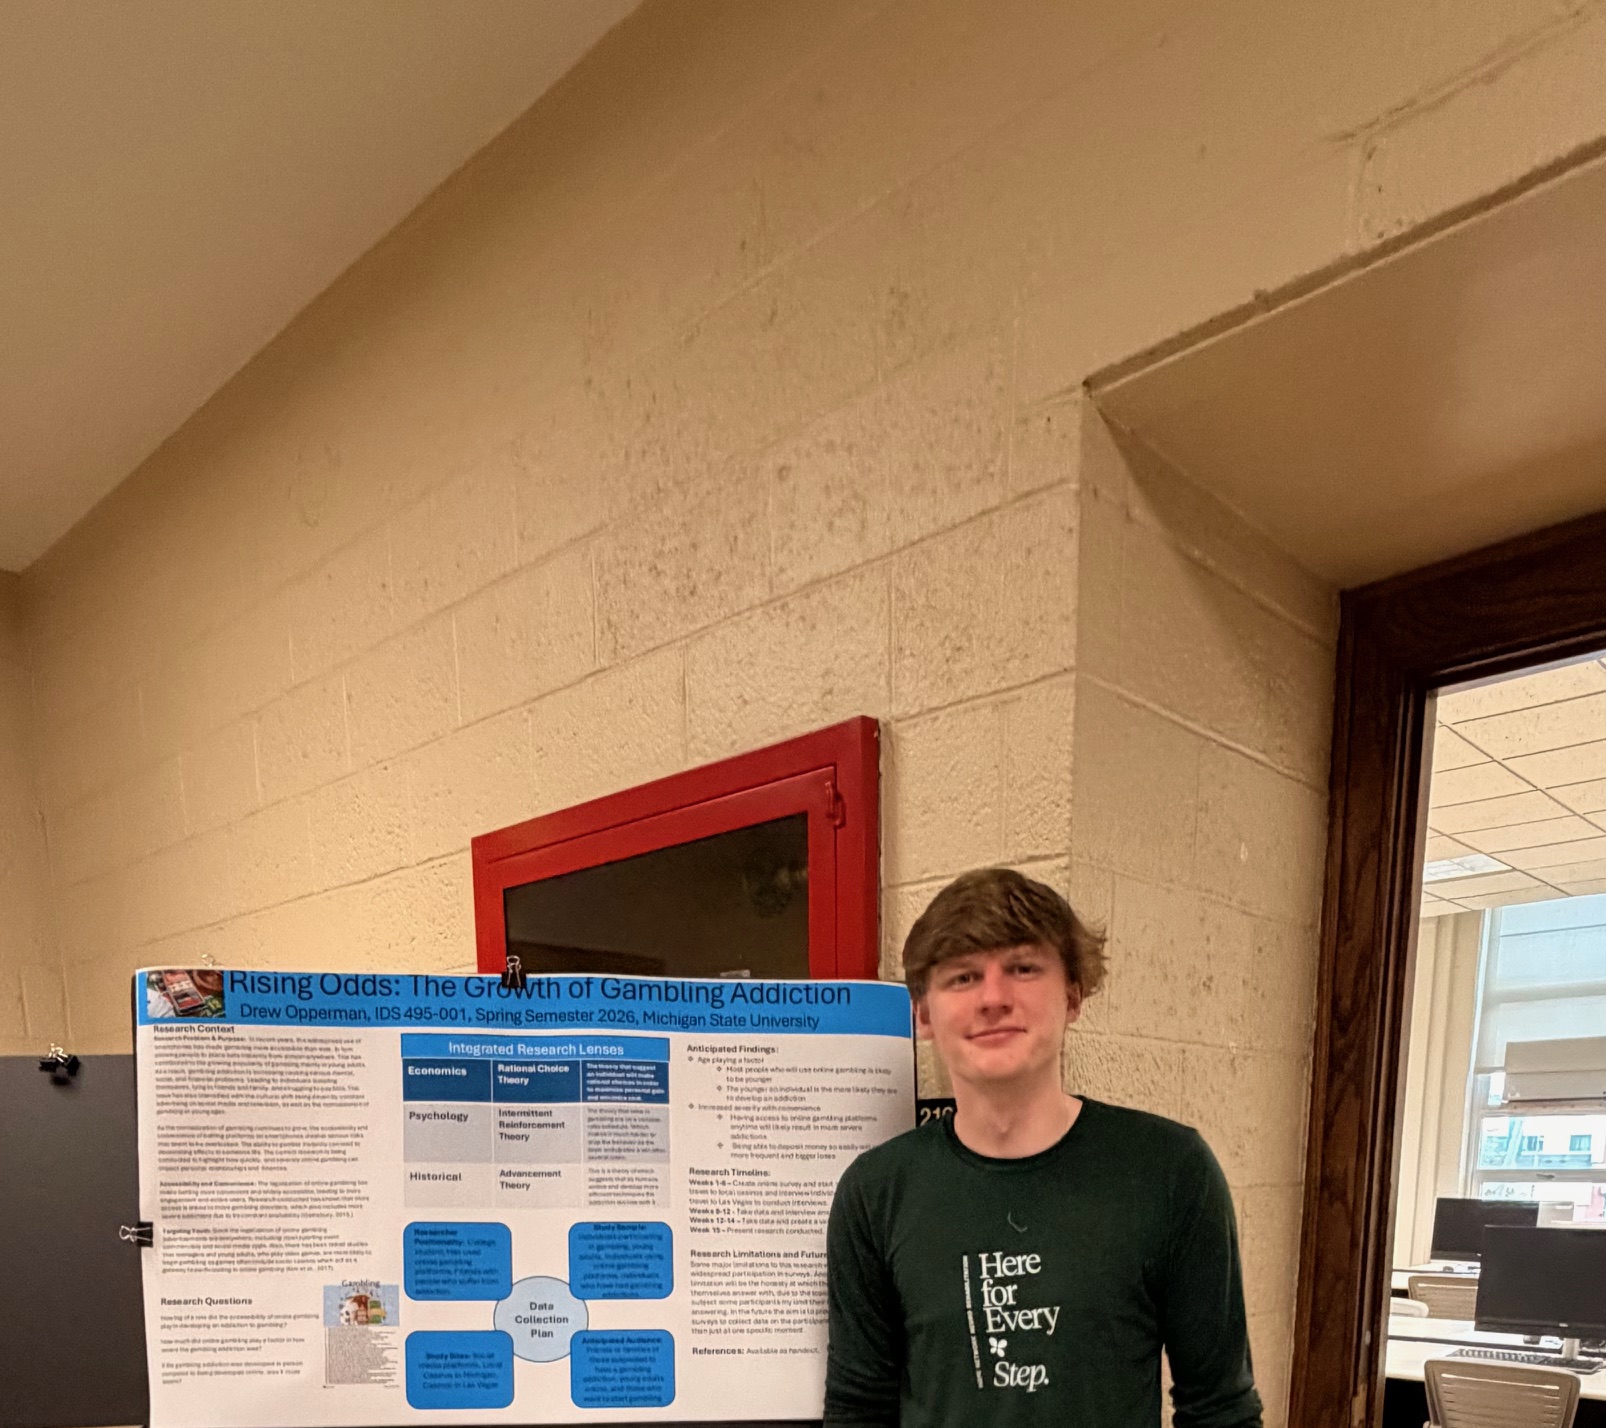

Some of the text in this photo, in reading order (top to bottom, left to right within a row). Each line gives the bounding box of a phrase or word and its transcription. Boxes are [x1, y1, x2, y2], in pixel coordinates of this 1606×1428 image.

[230, 971, 852, 1008] Rising Odds: The Growth of Gambling Addiction
[240, 1004, 820, 1031] Drew Opperman, IDS 495-001, Spring Semester 2026, Michigan State University
[154, 1025, 235, 1034] Research Context
[448, 1042, 624, 1056] Integrated Research Lenses
[687, 1045, 778, 1054] Anticipated Findings:
[408, 1066, 468, 1076] Economics
[498, 1064, 570, 1073] Rational Choice
[498, 1076, 530, 1086] Theory
[409, 1112, 468, 1122] Psychology
[498, 1109, 552, 1118] Intermittent
[498, 1120, 565, 1129] Reinforcement
[499, 1132, 530, 1142] Theory
[410, 1172, 462, 1182] Historical
[499, 1170, 562, 1178] Advancement
[689, 1168, 770, 1176] Research Timeline:
[500, 1181, 530, 1190] Theory
[732, 1250, 781, 1258] Limitations
[782, 1250, 799, 1258] and
[978, 1252, 1042, 1279] Here
[342, 1280, 380, 1288] Gambling
[980, 1278, 1018, 1308] for
[160, 1298, 252, 1306] Research Questions
[530, 1302, 554, 1311] Data
[514, 1314, 569, 1324] Collection
[983, 1306, 1061, 1336] Every
[530, 1328, 554, 1338] Plan
[994, 1361, 1050, 1393] Step.
